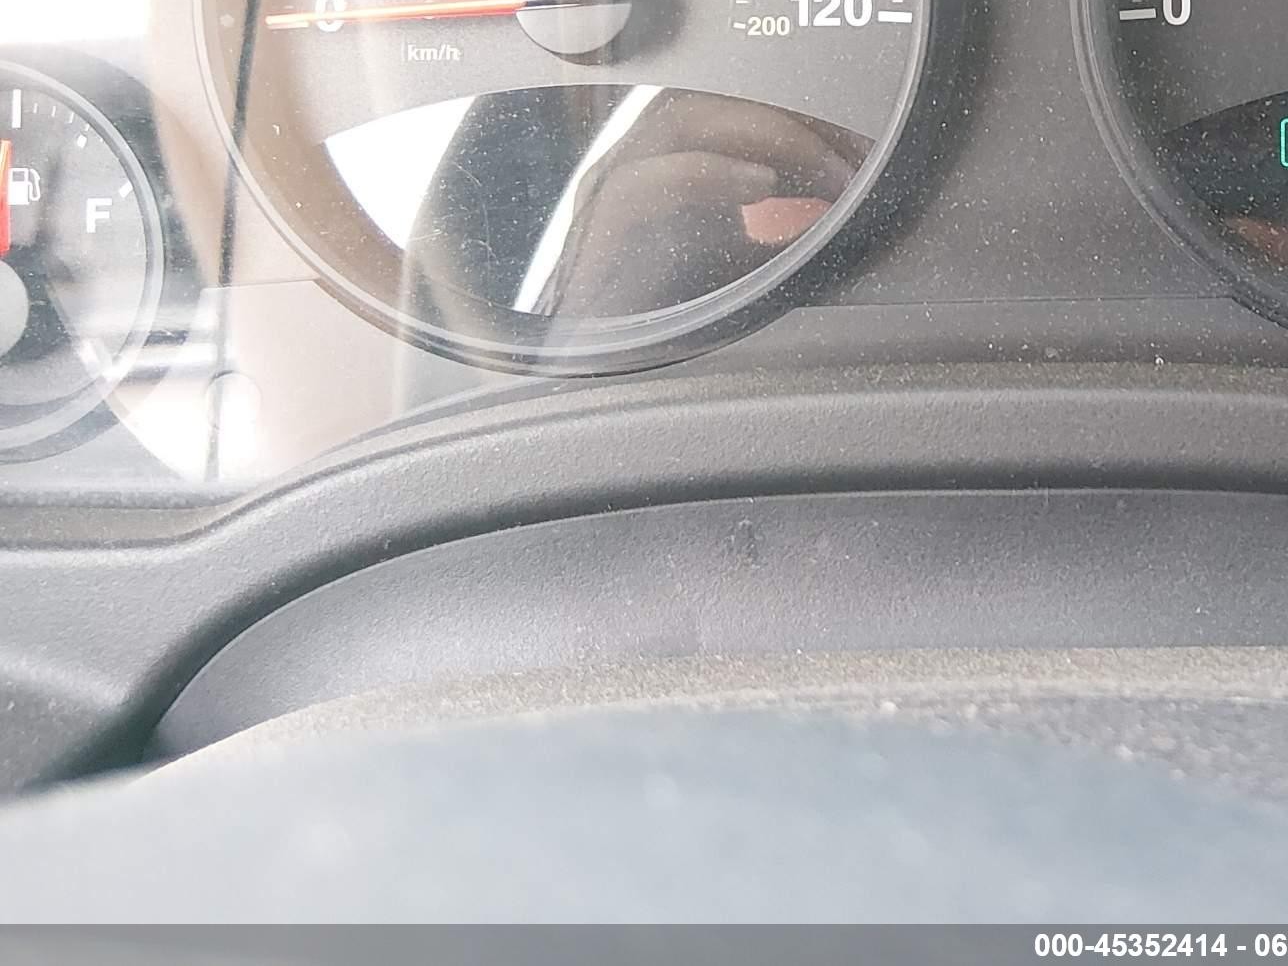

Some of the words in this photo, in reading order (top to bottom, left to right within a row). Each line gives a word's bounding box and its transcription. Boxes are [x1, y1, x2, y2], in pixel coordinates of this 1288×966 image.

[747, 16, 790, 36] 200
[407, 43, 461, 62] km/h
[86, 198, 112, 233] F
